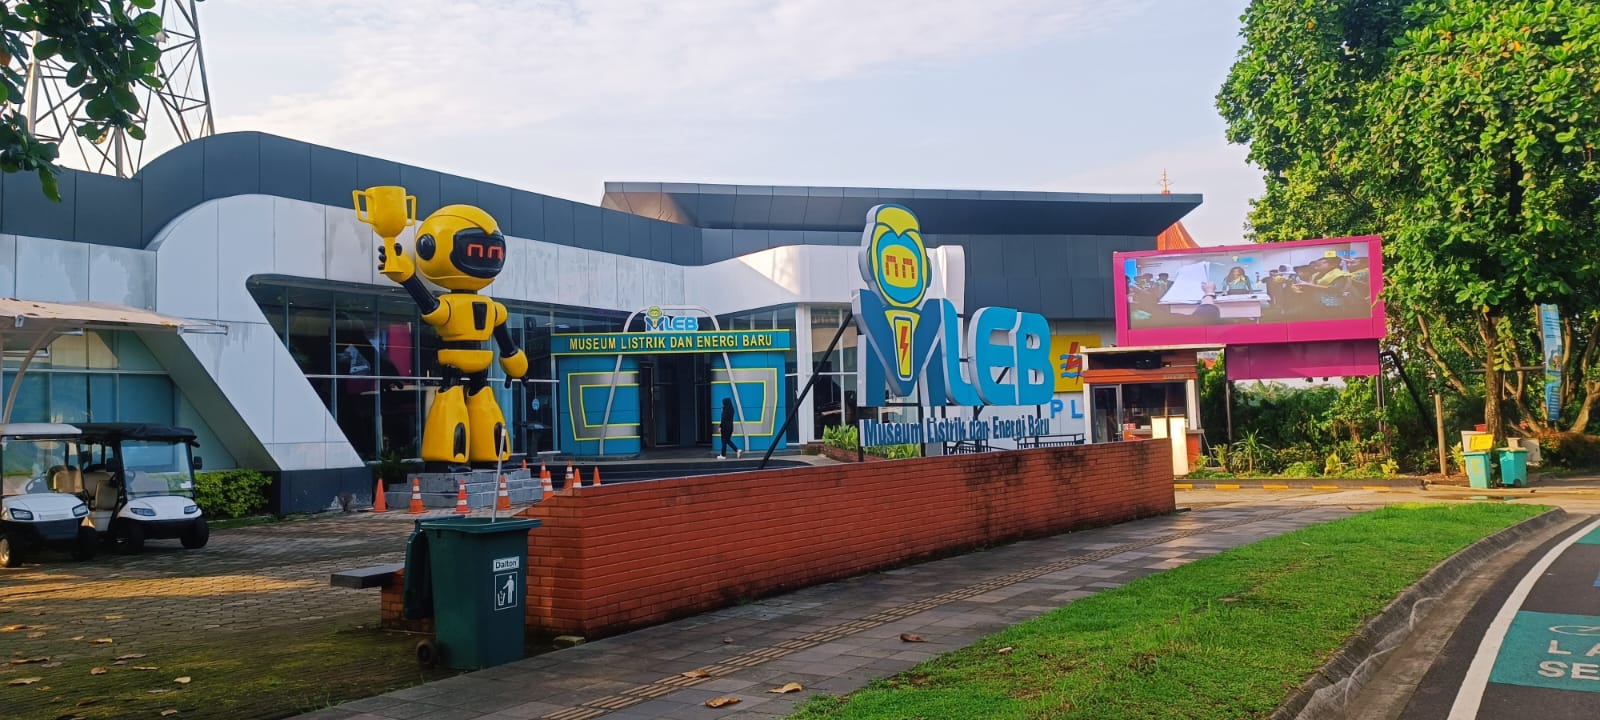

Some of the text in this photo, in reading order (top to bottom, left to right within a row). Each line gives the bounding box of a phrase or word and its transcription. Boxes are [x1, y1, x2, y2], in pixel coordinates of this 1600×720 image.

[644, 315, 698, 331] MLEB
[569, 334, 772, 350] MUSEUM LISTRIK DAN ENERGI BARU
[853, 288, 1055, 407] MLEB
[862, 415, 1050, 446] Museum Listrik dan Energi Baru
[496, 560, 517, 569] Dalton
